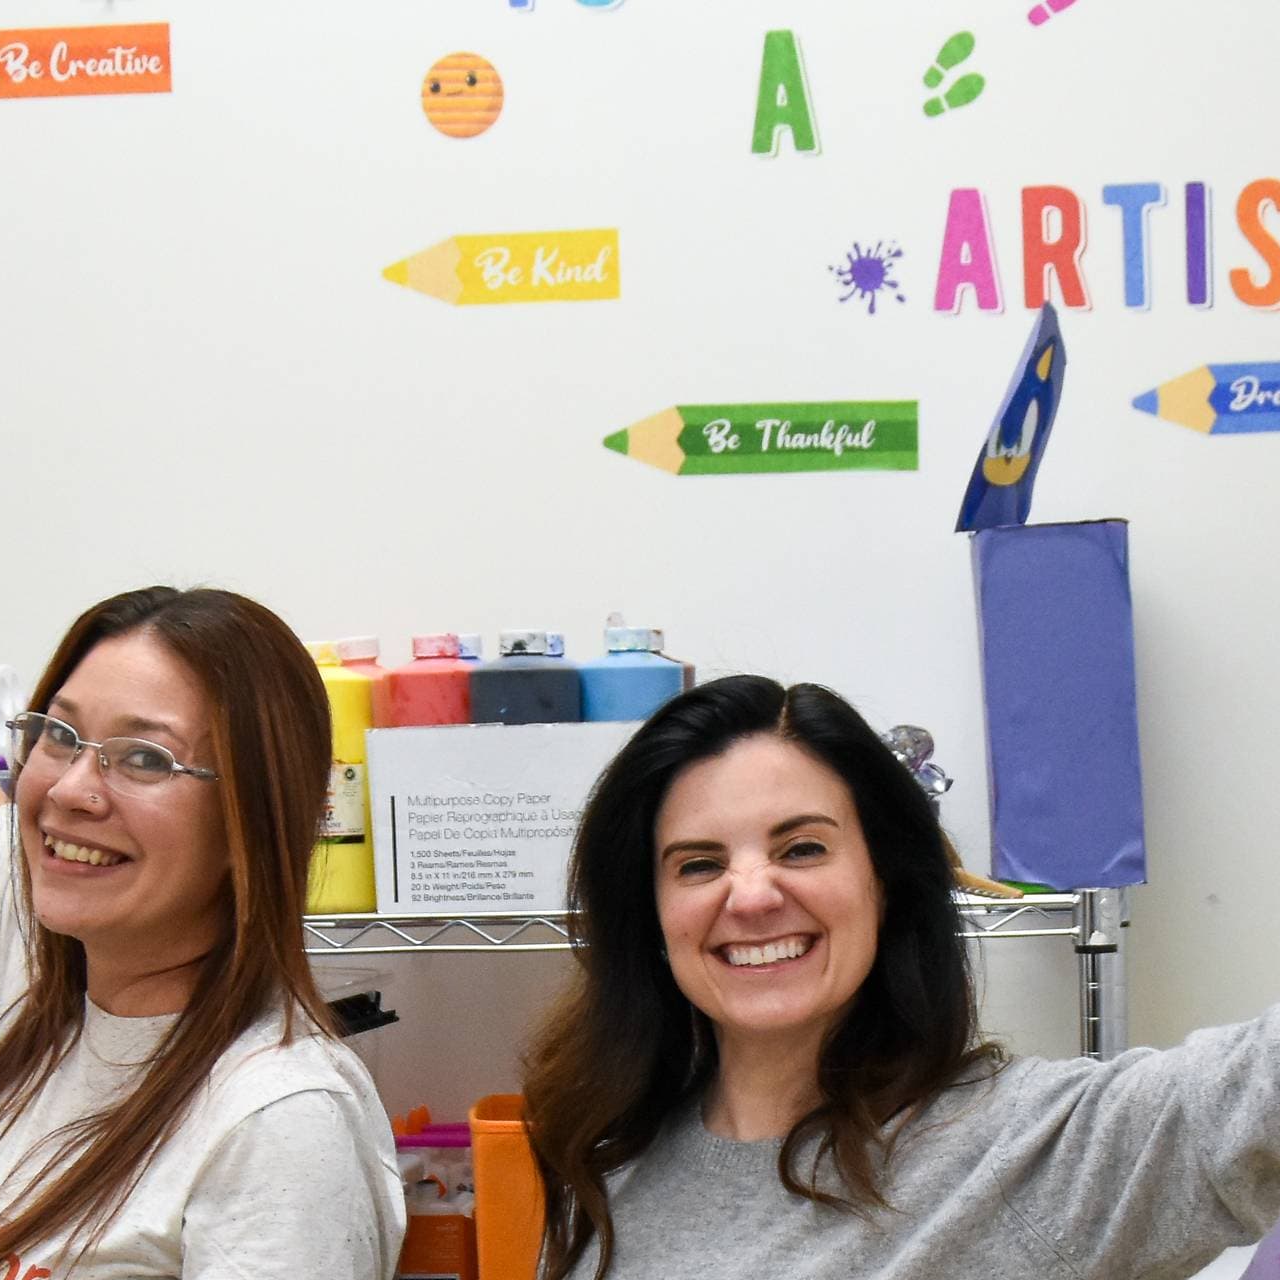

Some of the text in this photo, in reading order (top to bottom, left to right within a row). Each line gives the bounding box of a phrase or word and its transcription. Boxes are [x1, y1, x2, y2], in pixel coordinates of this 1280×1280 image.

[50, 41, 163, 80] Creative
[751, 28, 821, 157] A
[475, 244, 609, 289] Be Kind
[702, 417, 875, 457] Be Thankful
[407, 792, 551, 809] Multipurpose Copy Paper
[407, 811, 444, 825] Papier
[447, 810, 538, 825] Reprographique
[551, 808, 583, 823] Usag
[408, 828, 440, 841] Papel
[444, 829, 460, 840] De
[463, 827, 497, 841] Copia
[411, 872, 423, 881] 8.5
[478, 871, 493, 879] mm
[502, 870, 516, 879] 279
[518, 870, 534, 878] mm
[411, 882, 420, 891] 20
[423, 882, 430, 891] lb
[412, 894, 422, 902] 92
